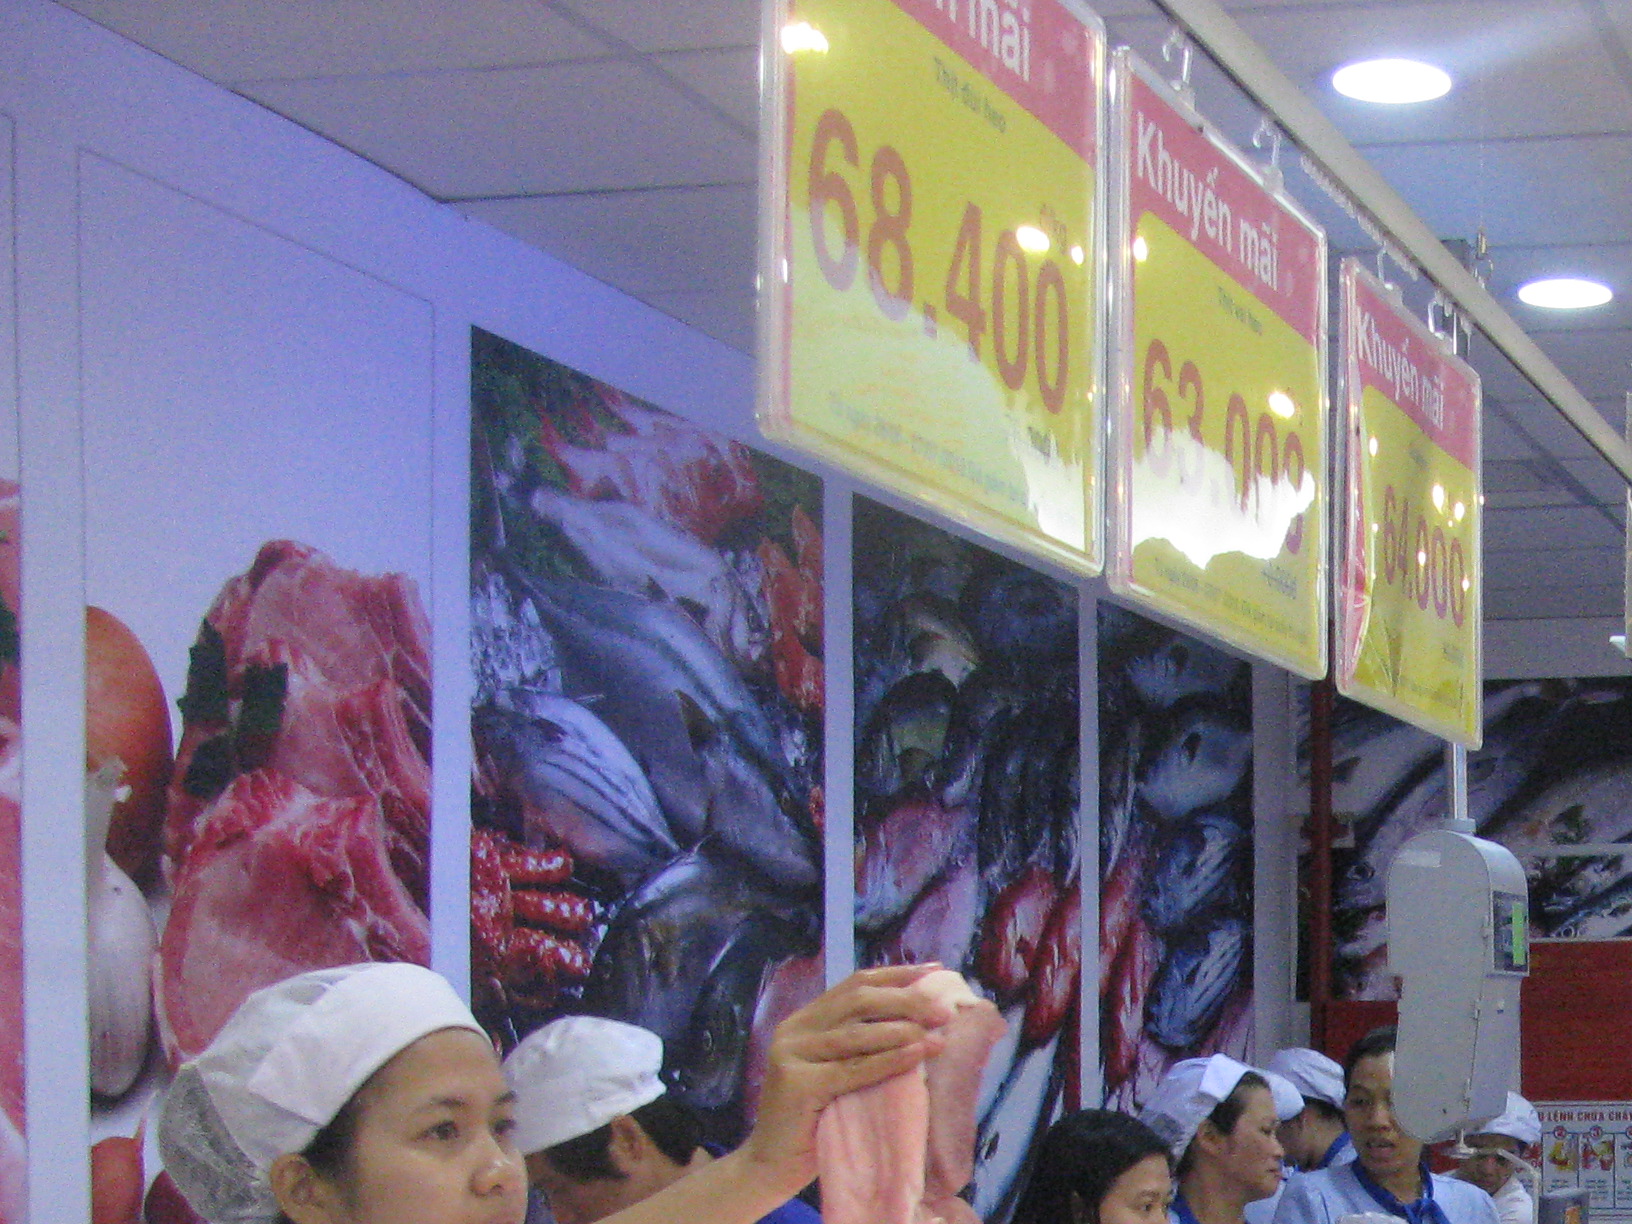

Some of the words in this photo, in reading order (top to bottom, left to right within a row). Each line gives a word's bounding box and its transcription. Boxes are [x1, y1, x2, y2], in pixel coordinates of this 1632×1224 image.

[808, 109, 1069, 415] 68.400
[1137, 112, 1233, 254] Khuyến
[1240, 218, 1279, 291] mãi
[1356, 306, 1419, 407] Khuyến
